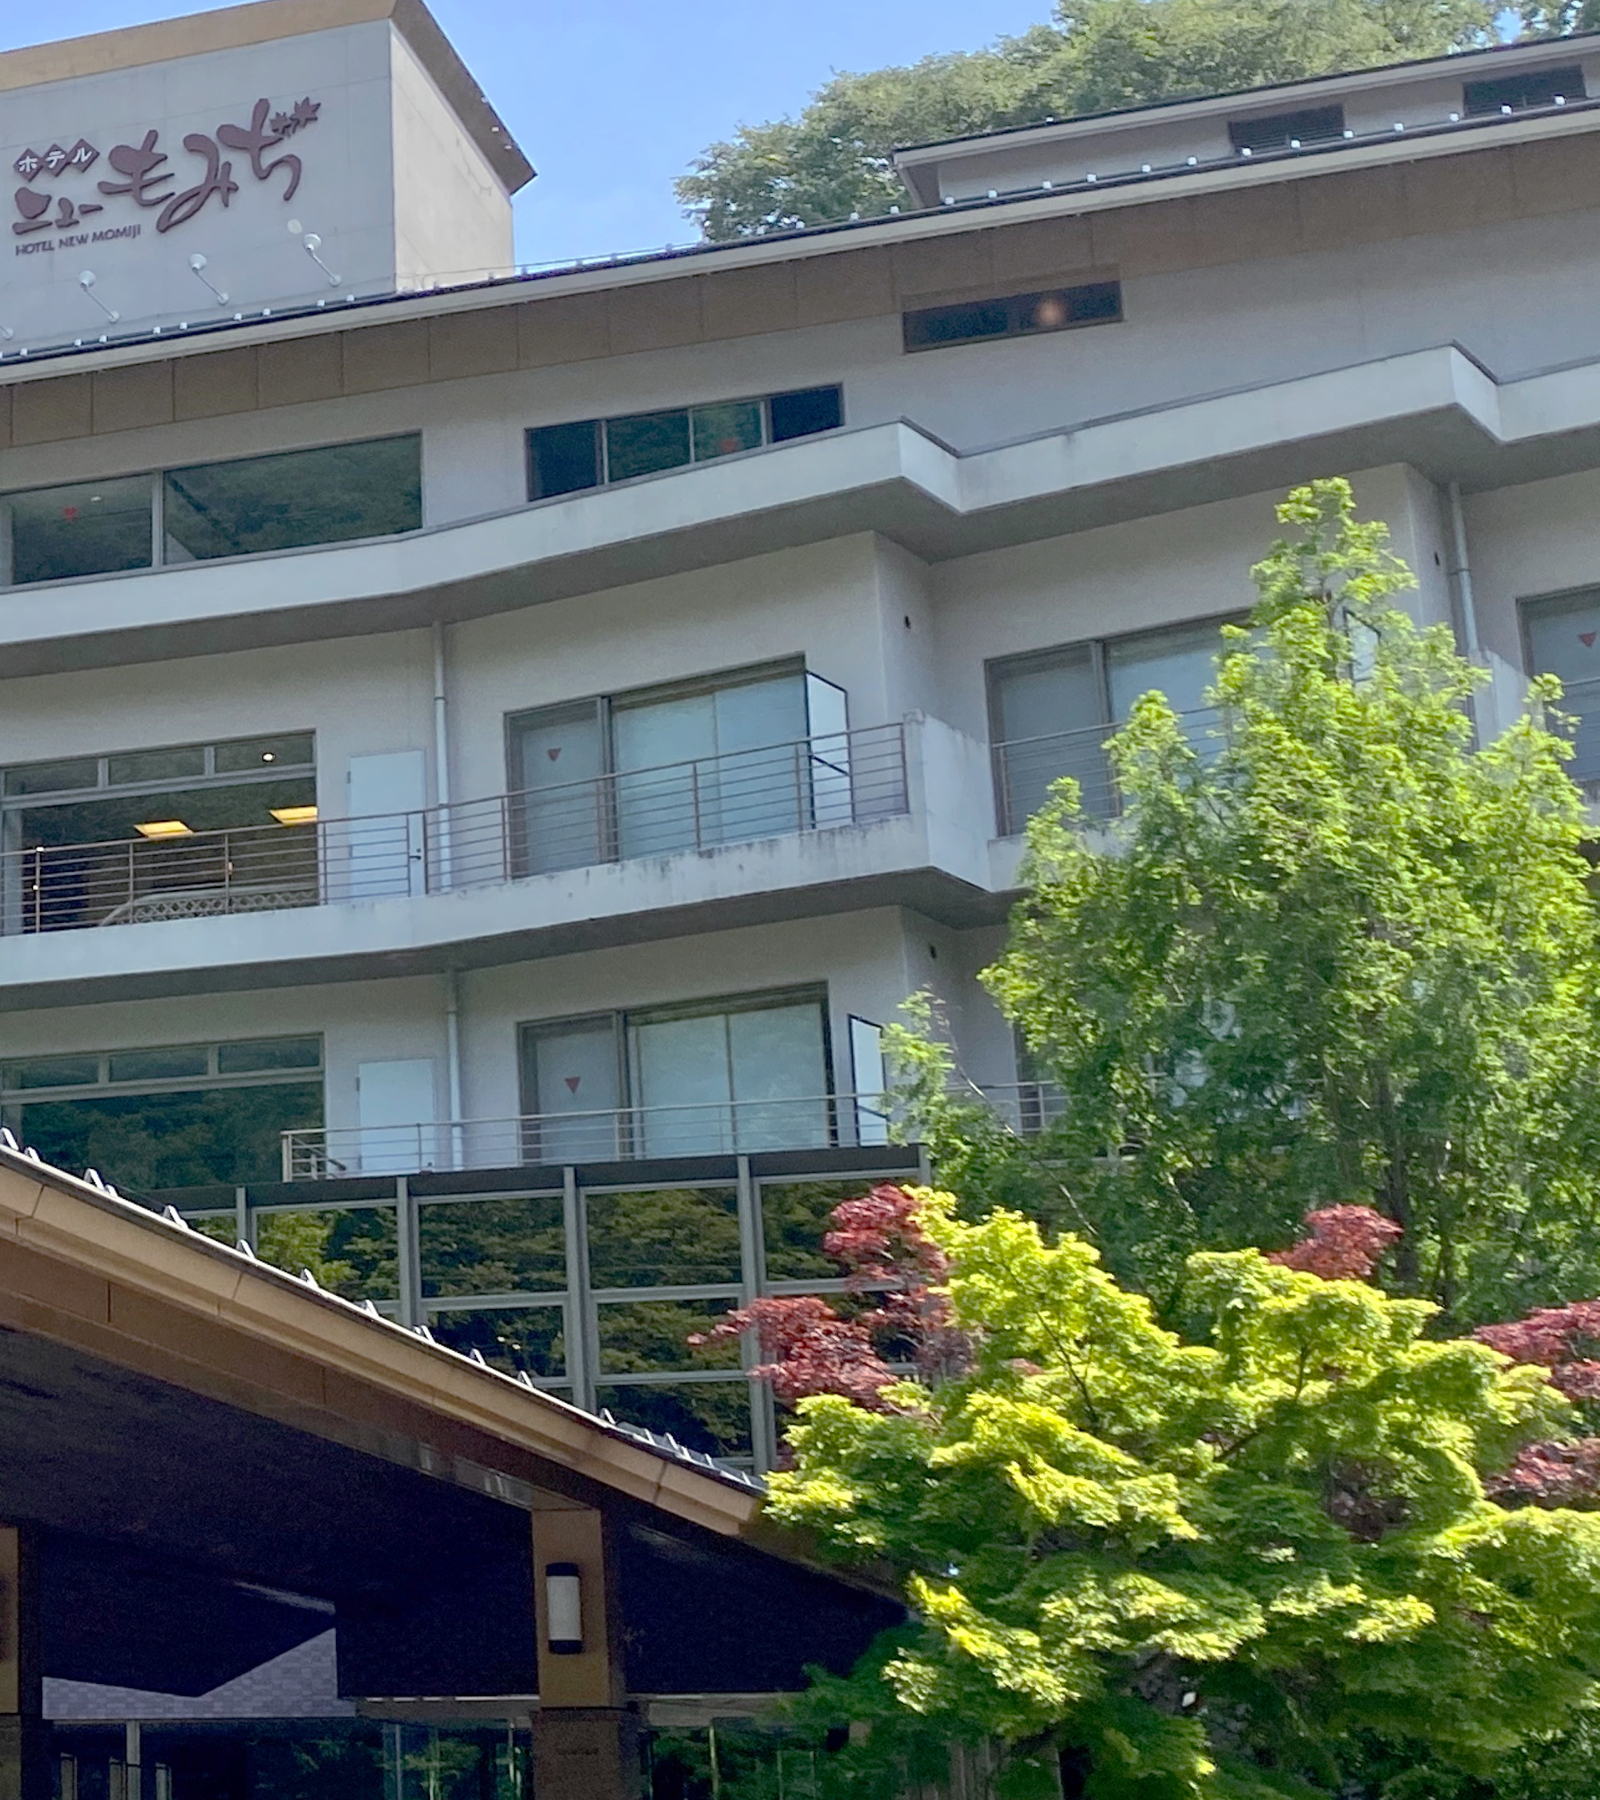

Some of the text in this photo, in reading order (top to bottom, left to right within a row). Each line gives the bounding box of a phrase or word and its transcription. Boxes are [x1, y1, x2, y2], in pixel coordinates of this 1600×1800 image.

[18, 146, 93, 173] ホテル
[15, 224, 141, 256] HOTEL NEW MOMIJI
